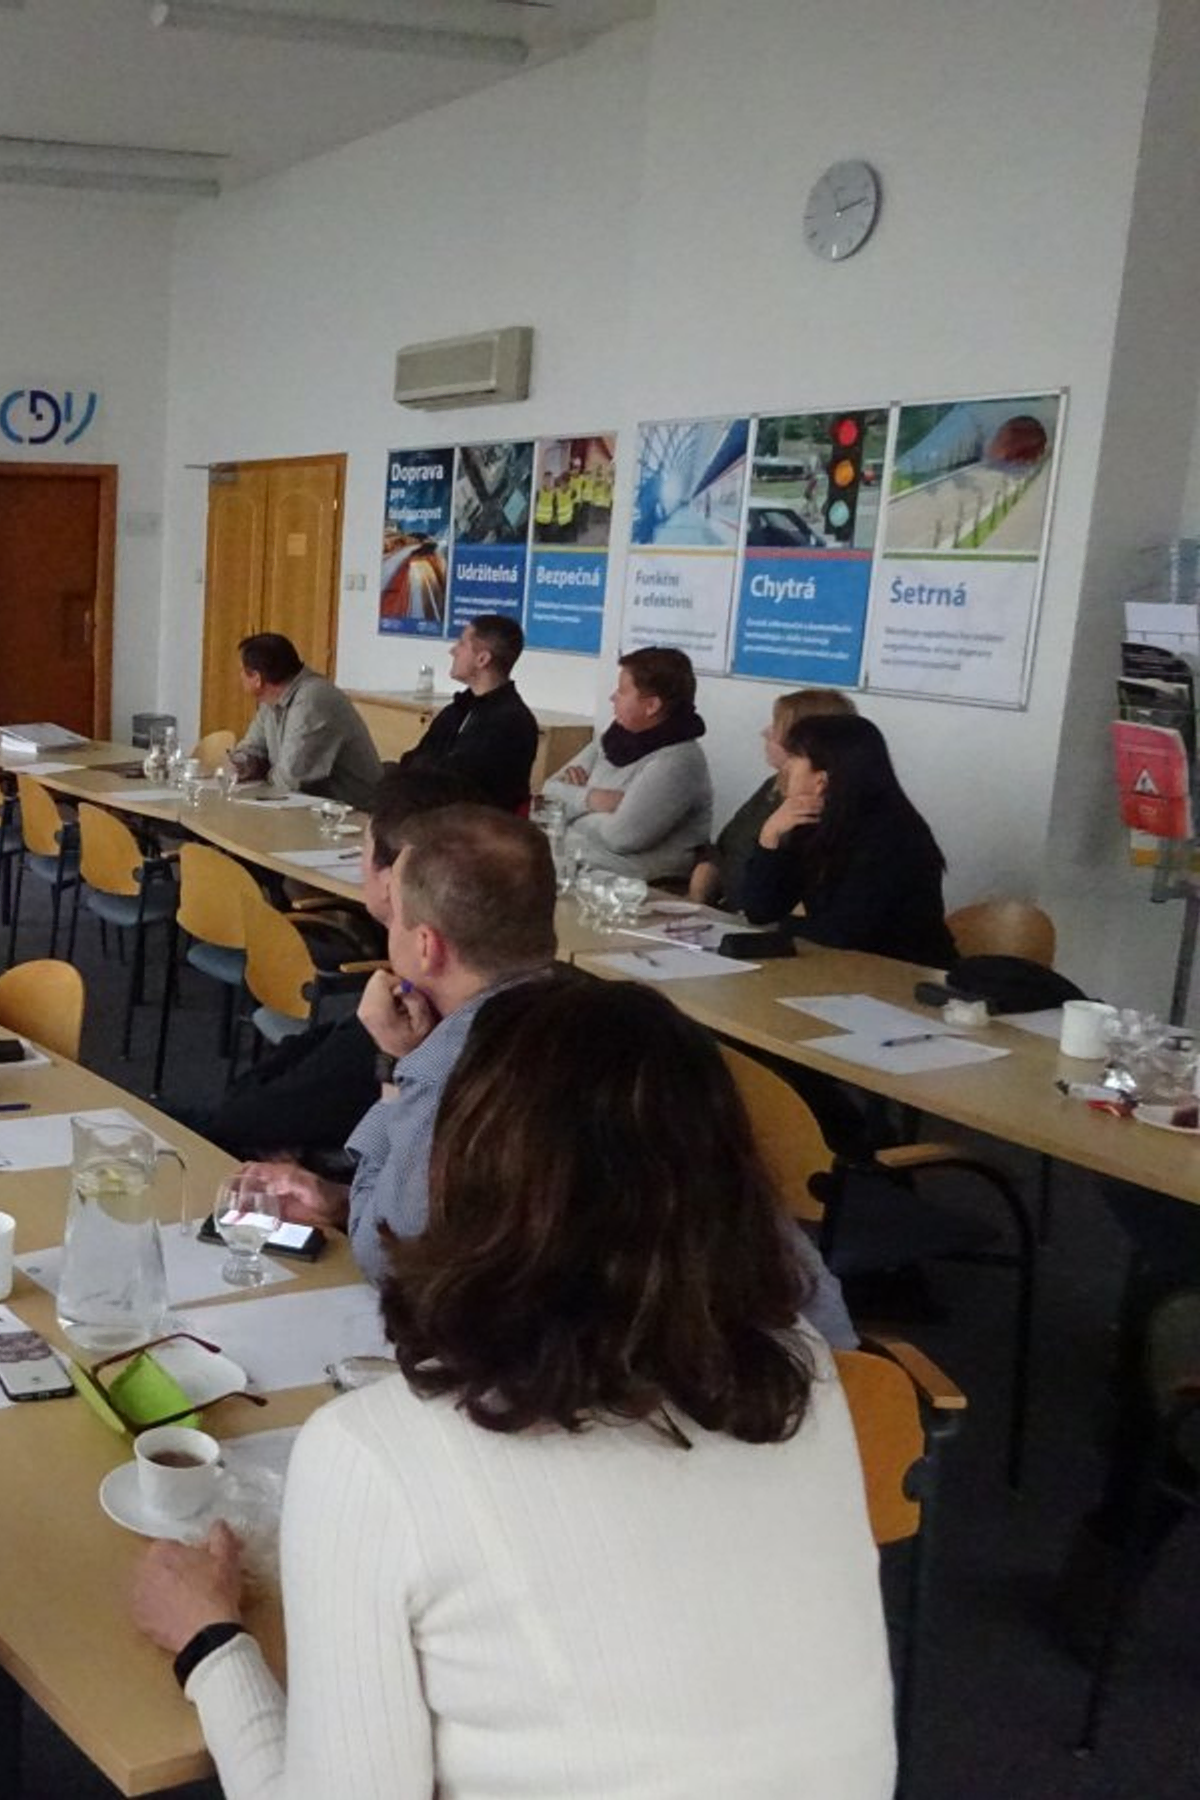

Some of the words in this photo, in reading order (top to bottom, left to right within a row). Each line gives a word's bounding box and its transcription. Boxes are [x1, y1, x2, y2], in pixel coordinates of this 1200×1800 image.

[391, 462, 444, 485] Doprava
[456, 563, 518, 583] Udržitelná
[536, 565, 600, 589] Bezpečná
[750, 573, 816, 604] Chytrá
[889, 575, 967, 608] Šetrná
